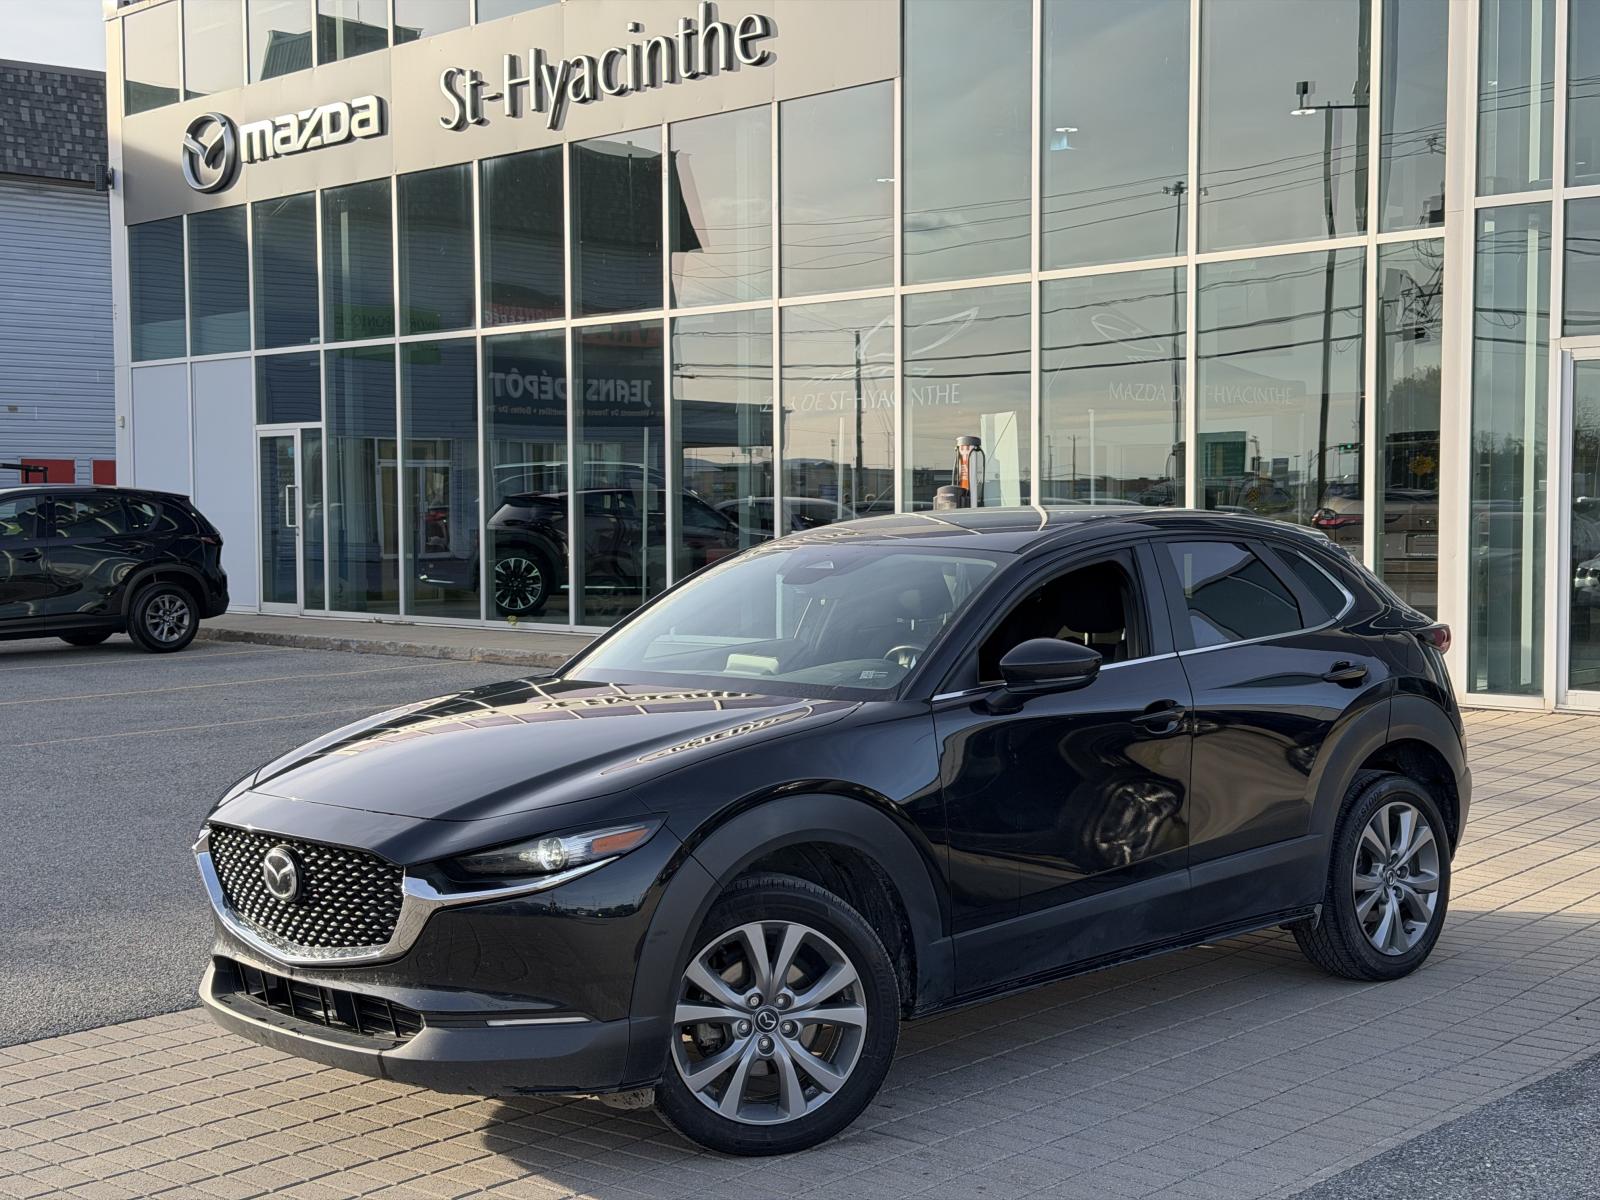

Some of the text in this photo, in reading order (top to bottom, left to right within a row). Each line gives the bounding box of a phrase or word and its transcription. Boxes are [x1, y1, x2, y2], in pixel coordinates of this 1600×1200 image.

[439, 1, 775, 130] St-Hyacinthe
[239, 95, 381, 164] mazda
[829, 383, 960, 412] ST-HYANTHE
[1108, 382, 1167, 401] MAZDA
